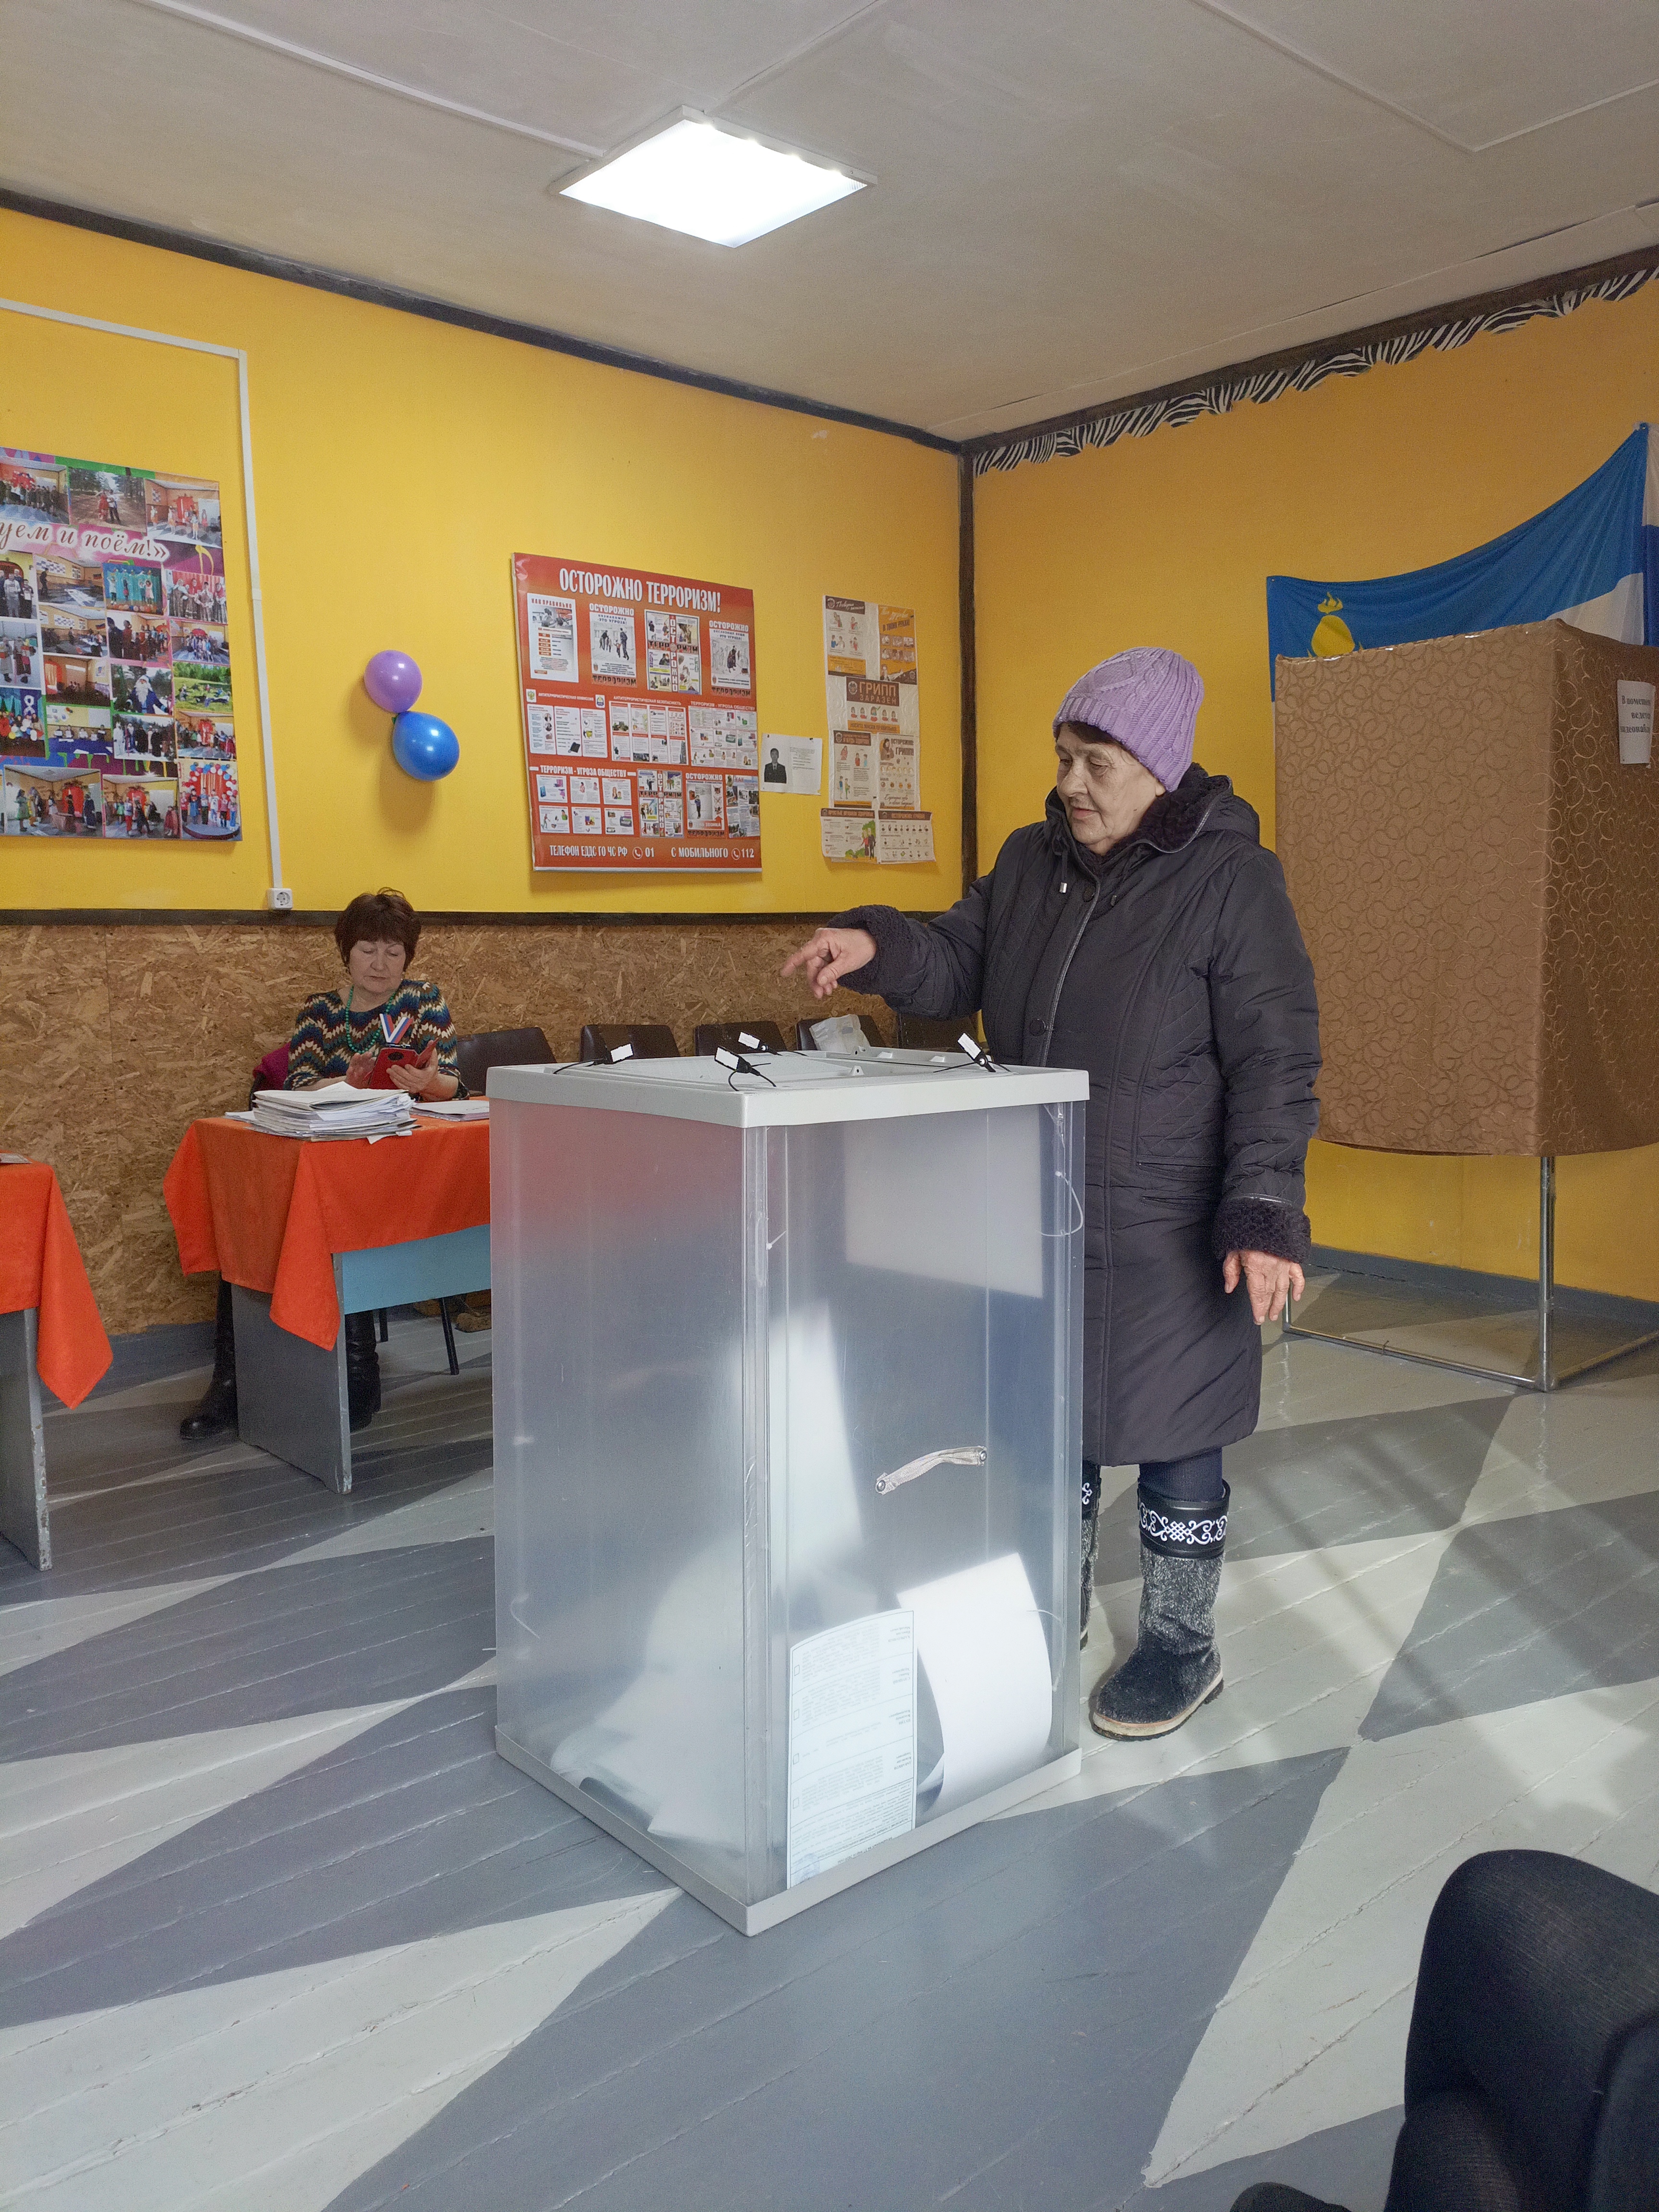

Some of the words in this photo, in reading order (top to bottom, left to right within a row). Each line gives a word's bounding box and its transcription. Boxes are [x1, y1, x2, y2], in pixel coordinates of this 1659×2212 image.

[60, 530, 74, 544] и
[559, 568, 642, 601] ОСТОРОЖНО
[646, 581, 721, 613] ТЕРРОРИЗМ!
[589, 603, 634, 616] ОСТОРОЖНО
[709, 620, 749, 632] ОСТОРОЖНО
[859, 682, 896, 697] ГРИПП
[859, 694, 897, 705] ЗАРАЗЕН
[540, 765, 573, 775] ТЕРРОРИЗМ
[577, 767, 597, 776] УГРОЗА
[597, 769, 626, 778] ОБЩЕСТВУ
[685, 773, 722, 781] ОСТОРОЖНО
[550, 845, 579, 856] ТЕЛЕФОН
[581, 846, 597, 857] ЕДДС
[598, 846, 606, 856] ГО
[607, 846, 616, 856] ЧС
[618, 846, 628, 857] РФ
[645, 847, 654, 857] 01
[671, 847, 676, 857] С
[678, 848, 728, 858] МОБИЛЬНОГО
[741, 848, 755, 858] 112
